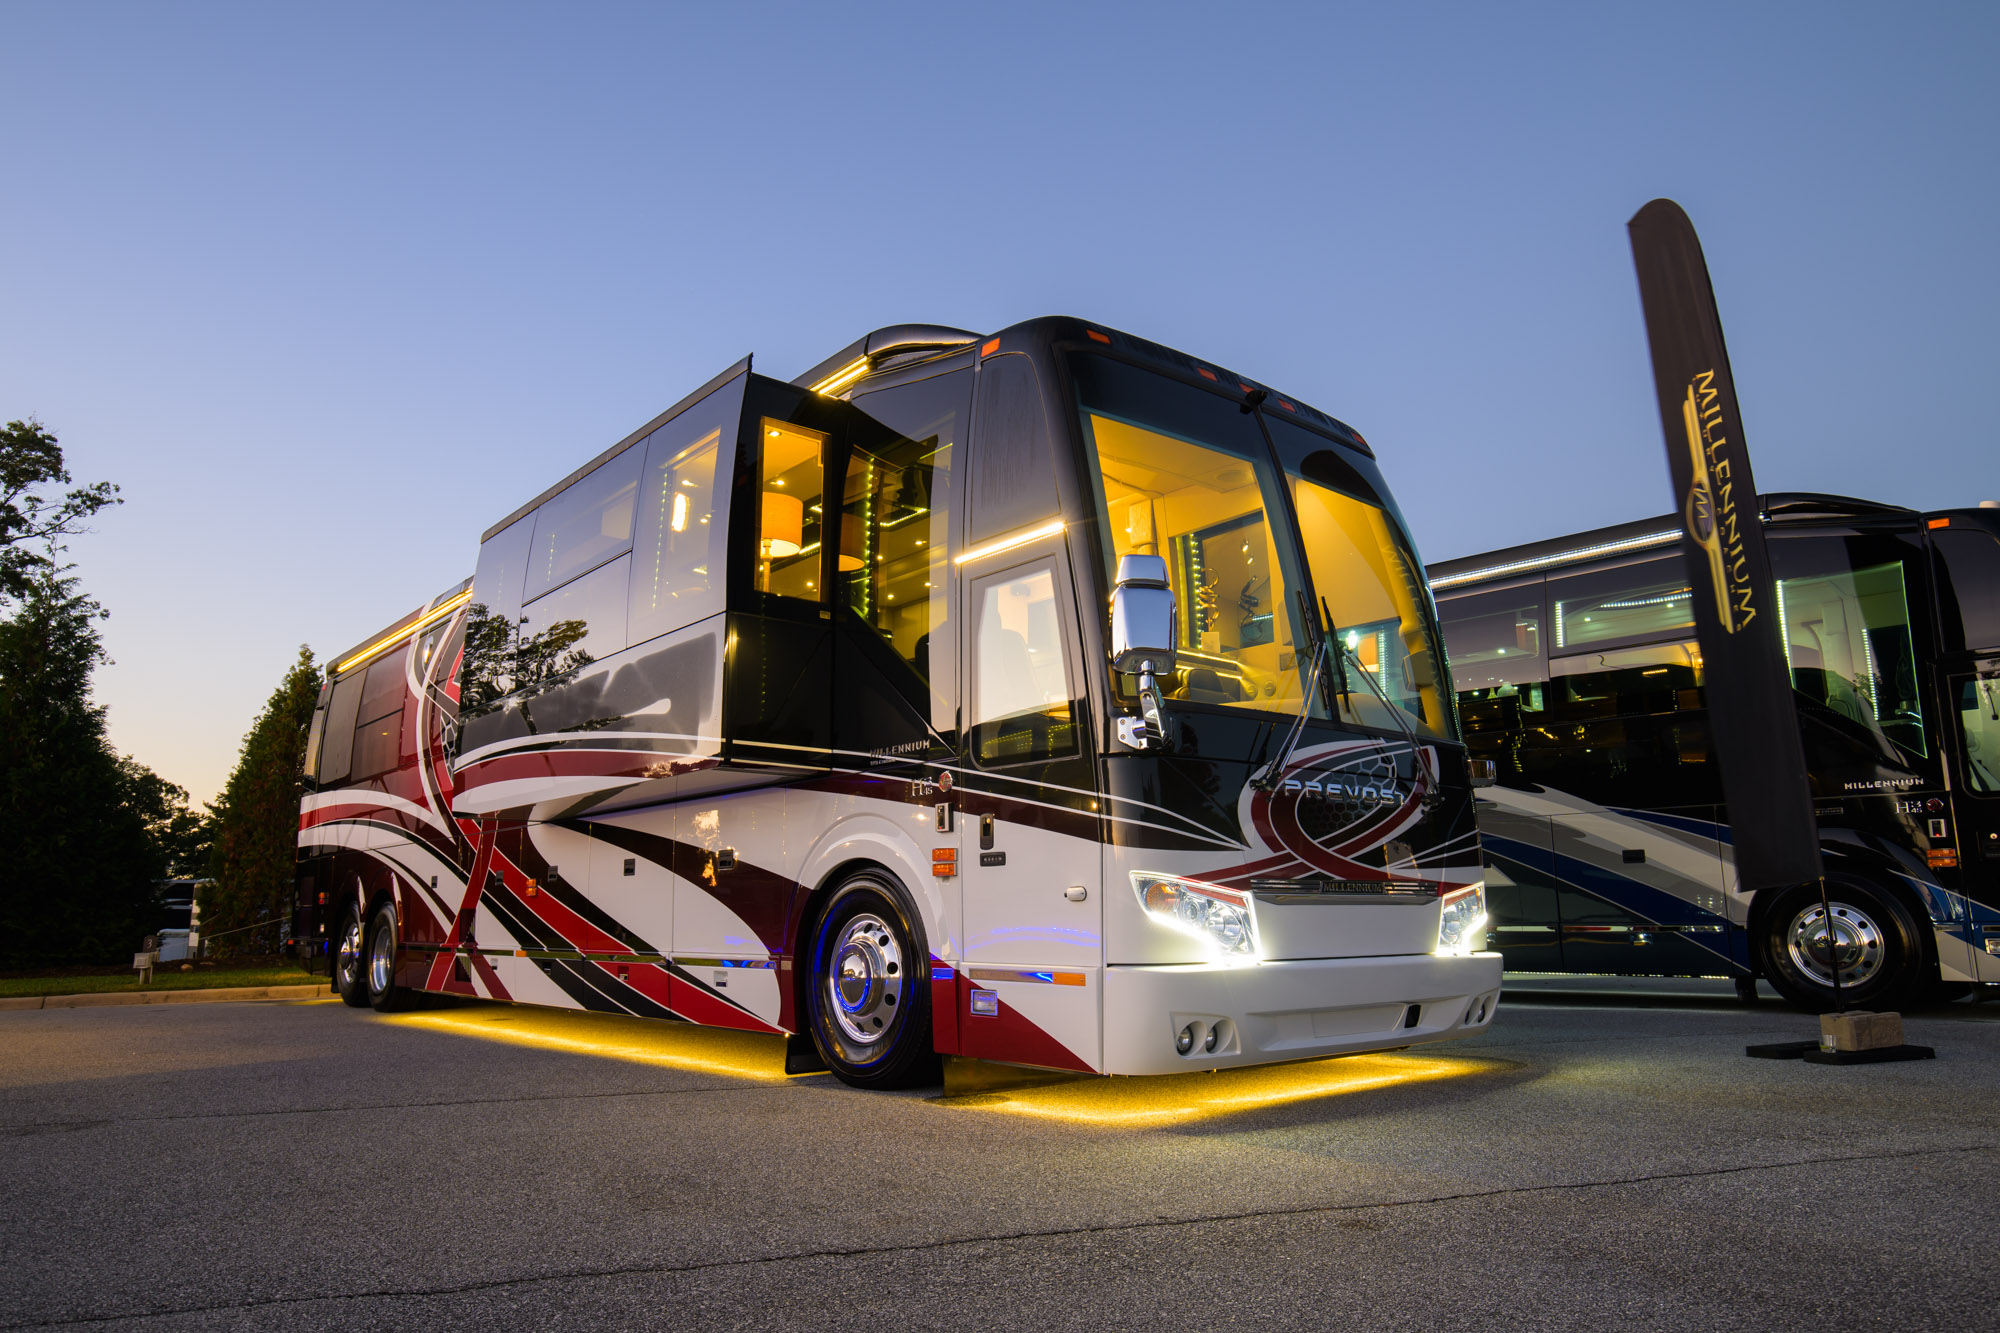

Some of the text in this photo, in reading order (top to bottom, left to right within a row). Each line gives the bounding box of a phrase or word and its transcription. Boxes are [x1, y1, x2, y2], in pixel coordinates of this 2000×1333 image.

[1696, 368, 1757, 628] MILLENNIUM
[1284, 779, 1405, 806] PREVOST
[1844, 778, 1925, 790] MILLENNIUM
[1323, 882, 1382, 893] MILLENNIUM
